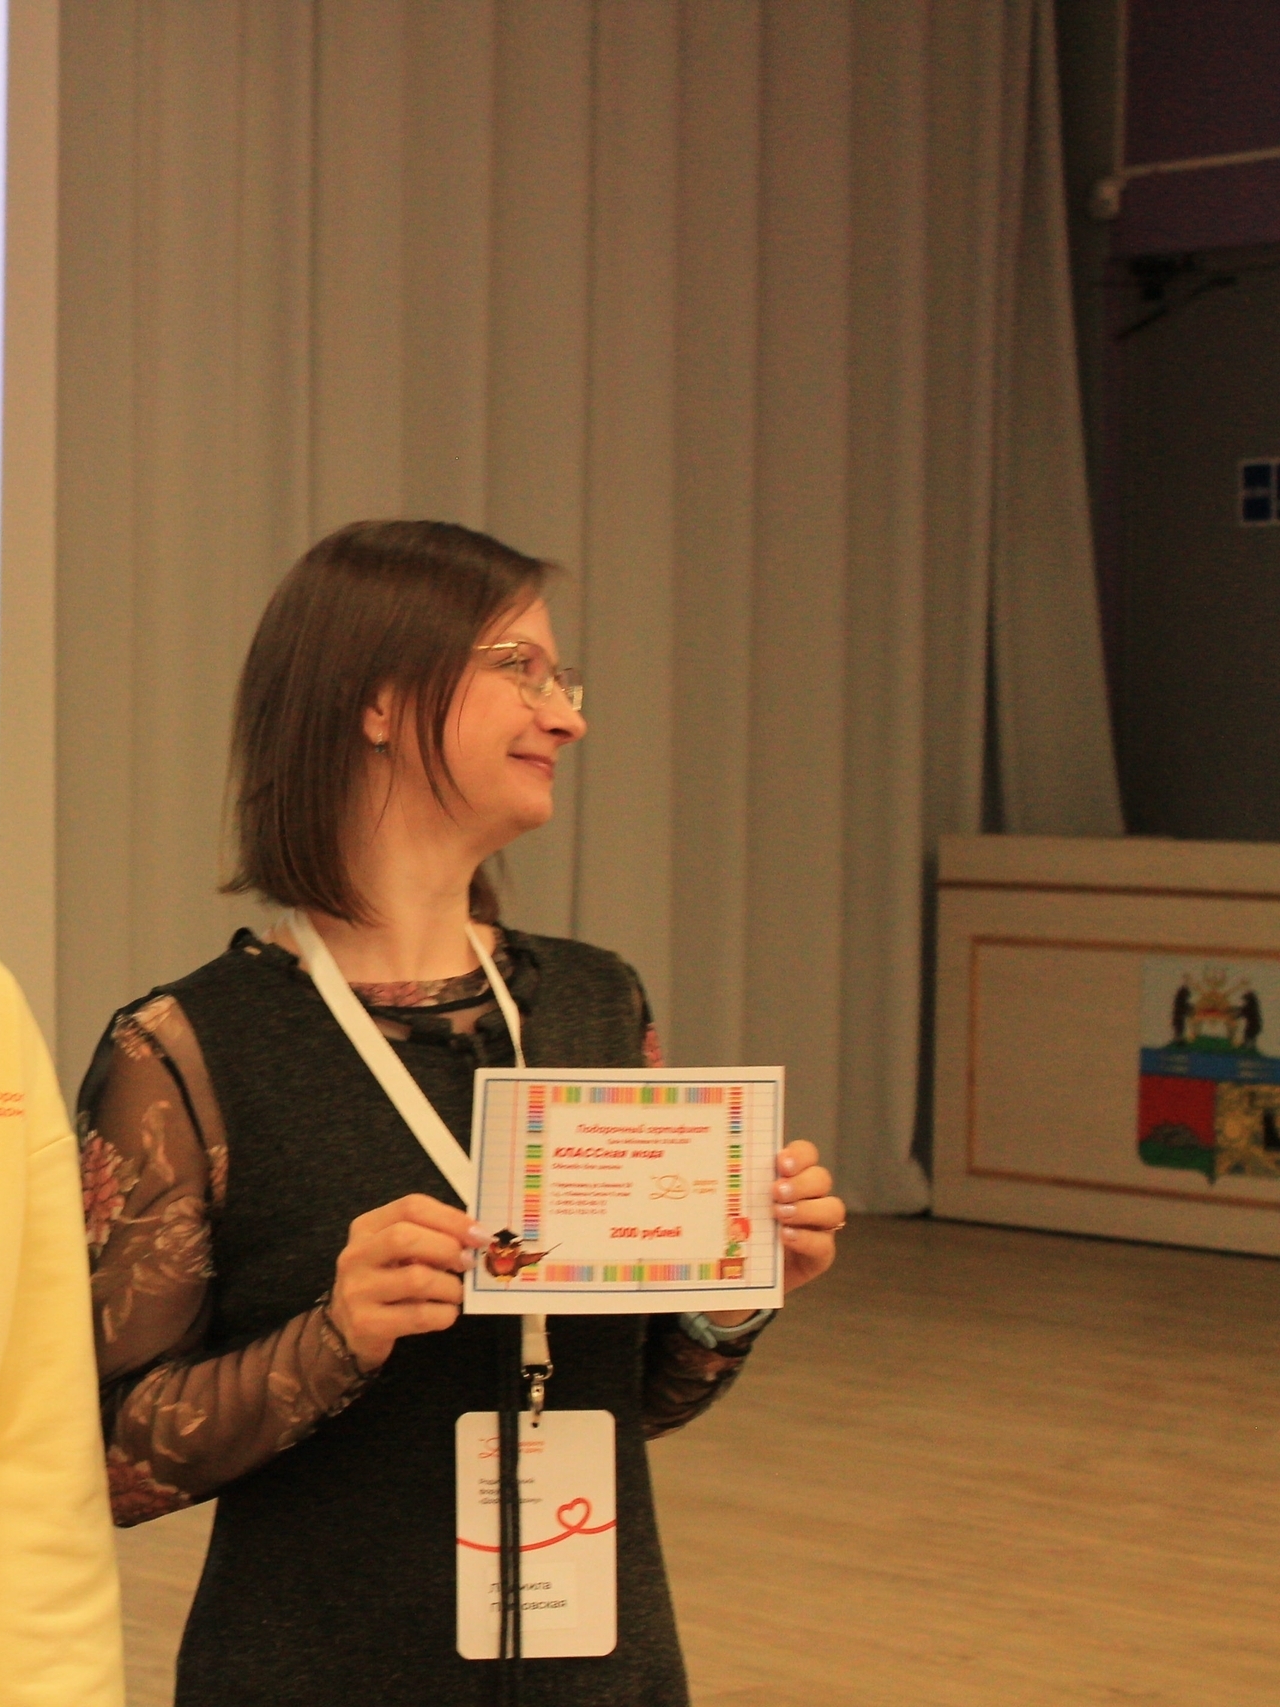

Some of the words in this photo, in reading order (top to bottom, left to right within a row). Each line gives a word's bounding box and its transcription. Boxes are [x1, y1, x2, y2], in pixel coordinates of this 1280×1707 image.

[552, 1147, 627, 1159] КЛАССная
[630, 1149, 664, 1159] мода
[610, 1226, 638, 1238] 2000
[641, 1226, 682, 1240] рублей
